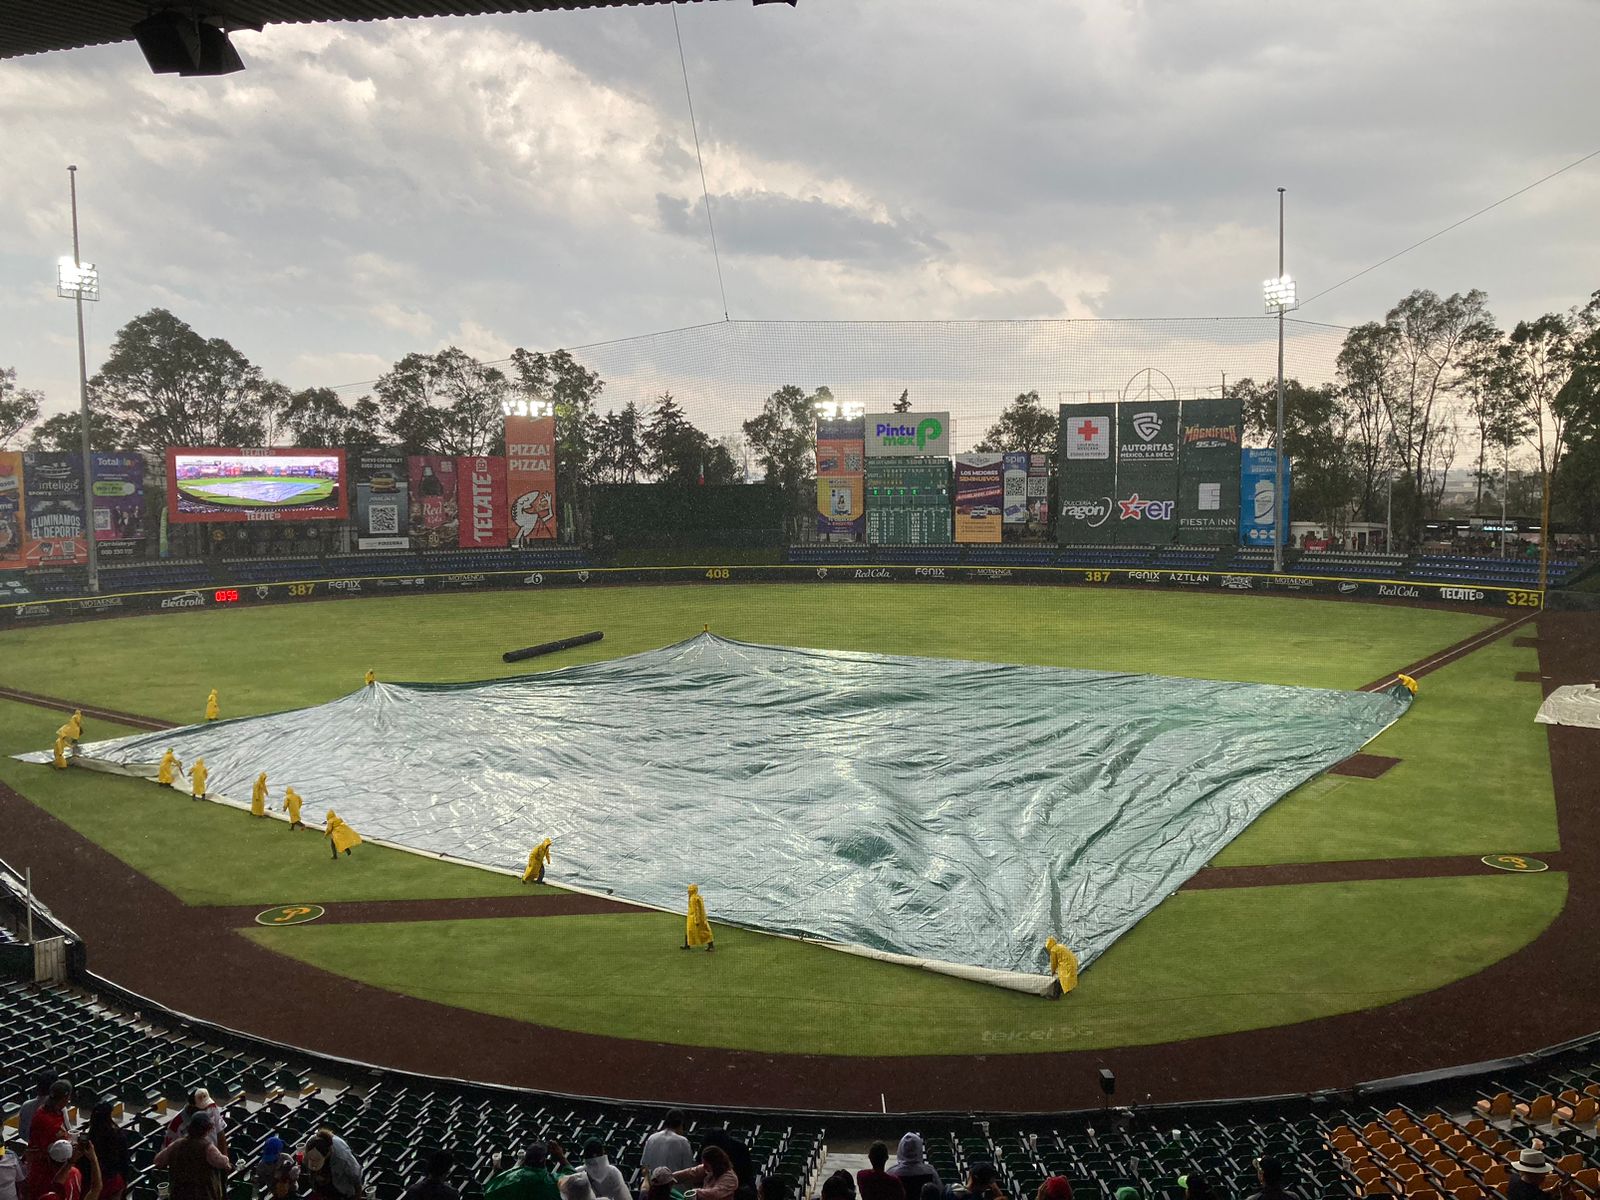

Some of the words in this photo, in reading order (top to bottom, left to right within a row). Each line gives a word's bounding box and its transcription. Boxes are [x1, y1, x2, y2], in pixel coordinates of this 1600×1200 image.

[876, 424, 915, 436] Pintu
[883, 437, 914, 446] mex
[510, 444, 550, 456] PIZZA!
[1121, 444, 1174, 452] AUTORITAS
[510, 459, 550, 471] PIZZA!
[1006, 455, 1025, 464] spin
[472, 472, 493, 542] TECATE
[31, 513, 80, 529] ILUMINAMOS
[245, 512, 276, 520] TECATE
[32, 528, 42, 540] EL
[44, 526, 80, 538] DEPORTE
[706, 569, 730, 579] 408
[854, 569, 870, 578] Red
[870, 569, 891, 578] Cola
[1085, 572, 1110, 582] 387
[288, 584, 315, 596] 387
[1378, 585, 1396, 596] Red
[1397, 586, 1419, 598] Cola
[1440, 588, 1476, 600] TECATE
[161, 597, 206, 608] Electrolit
[1506, 592, 1539, 606] 325
